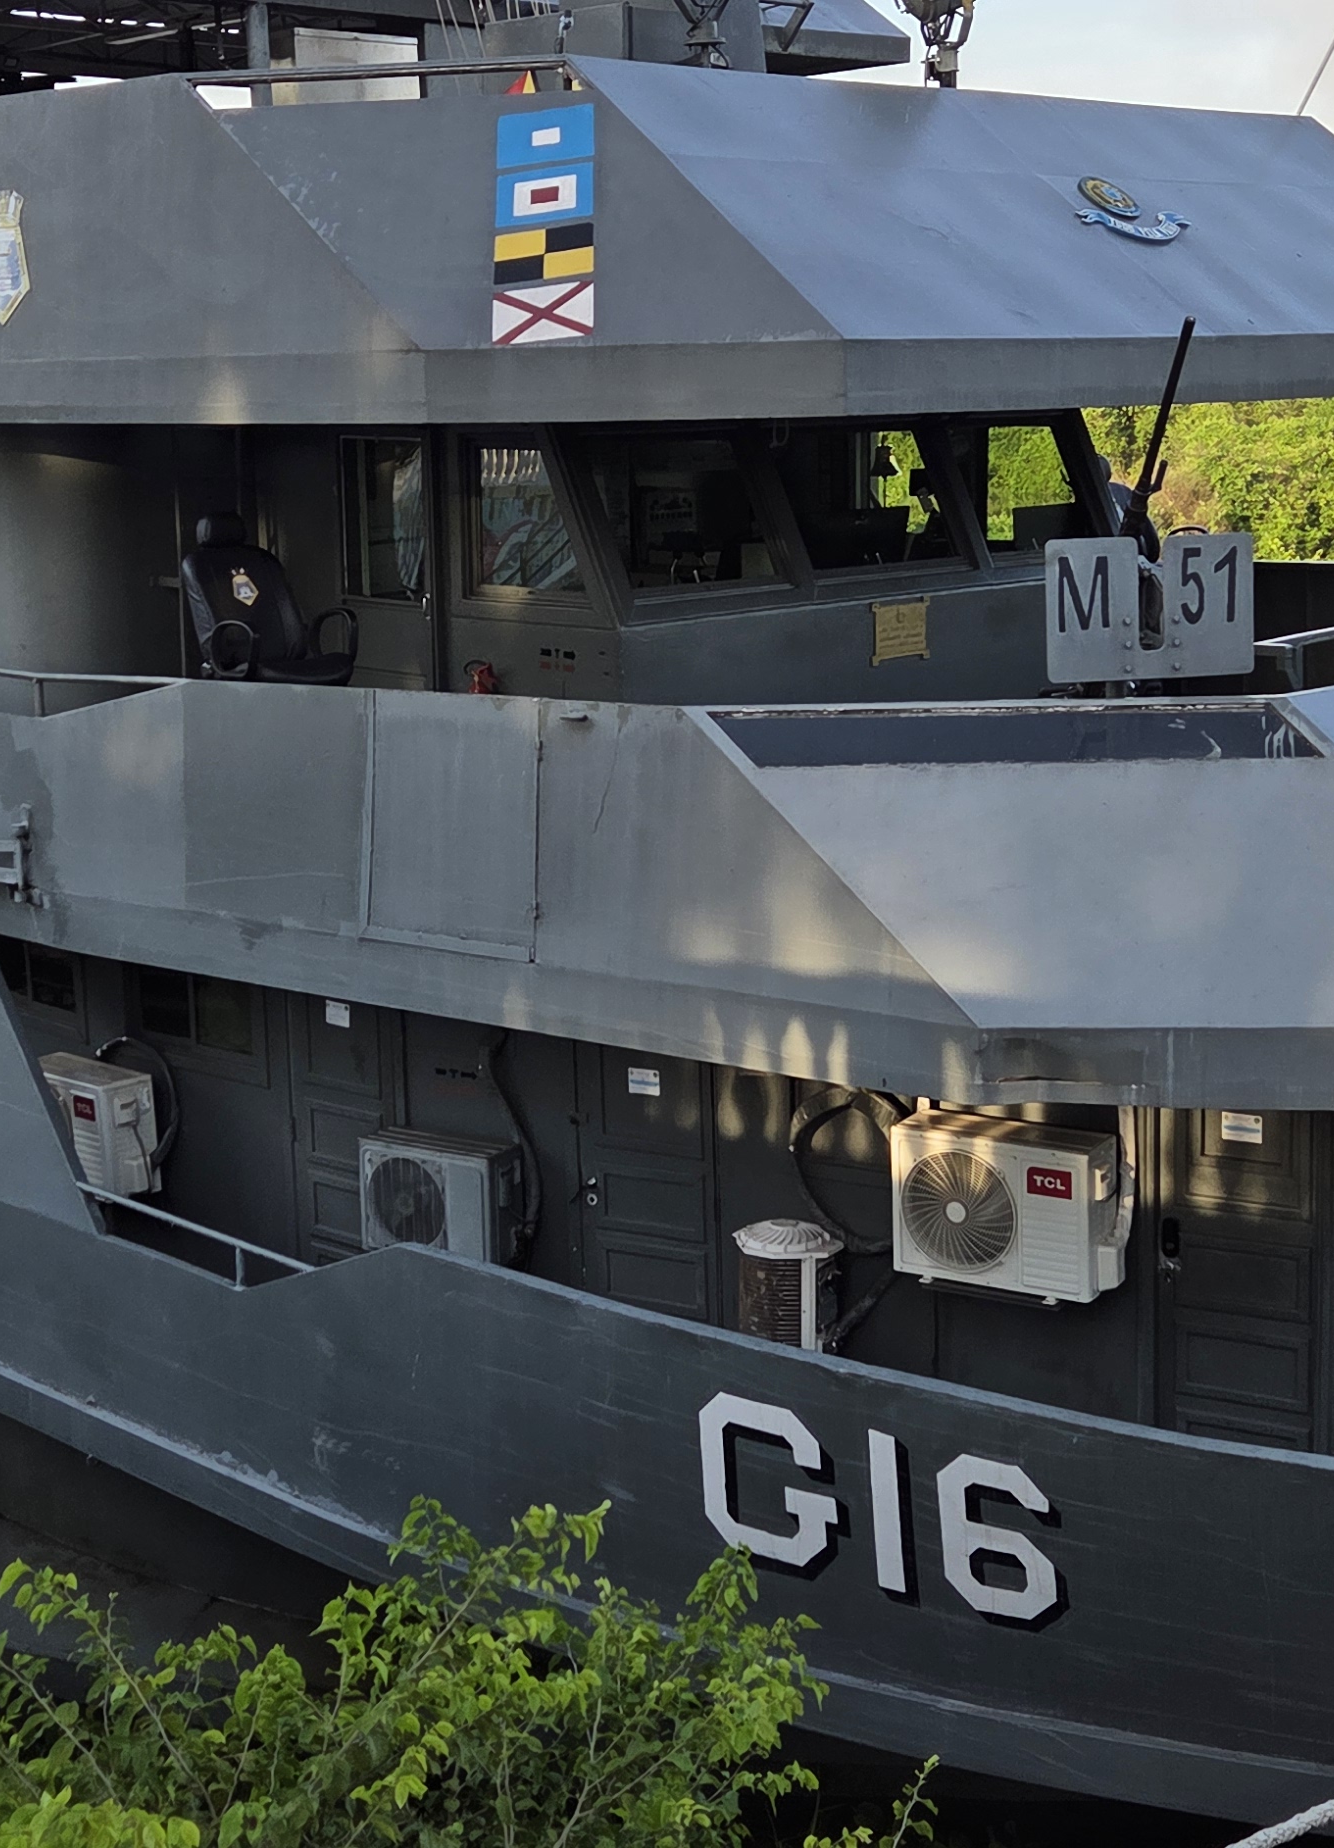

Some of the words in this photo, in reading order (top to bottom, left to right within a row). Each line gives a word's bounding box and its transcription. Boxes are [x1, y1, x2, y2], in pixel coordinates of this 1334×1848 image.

[1057, 555, 1110, 633] M
[1180, 545, 1238, 625] 51
[1033, 1174, 1066, 1191] TCL
[698, 1391, 1065, 1626] G16
